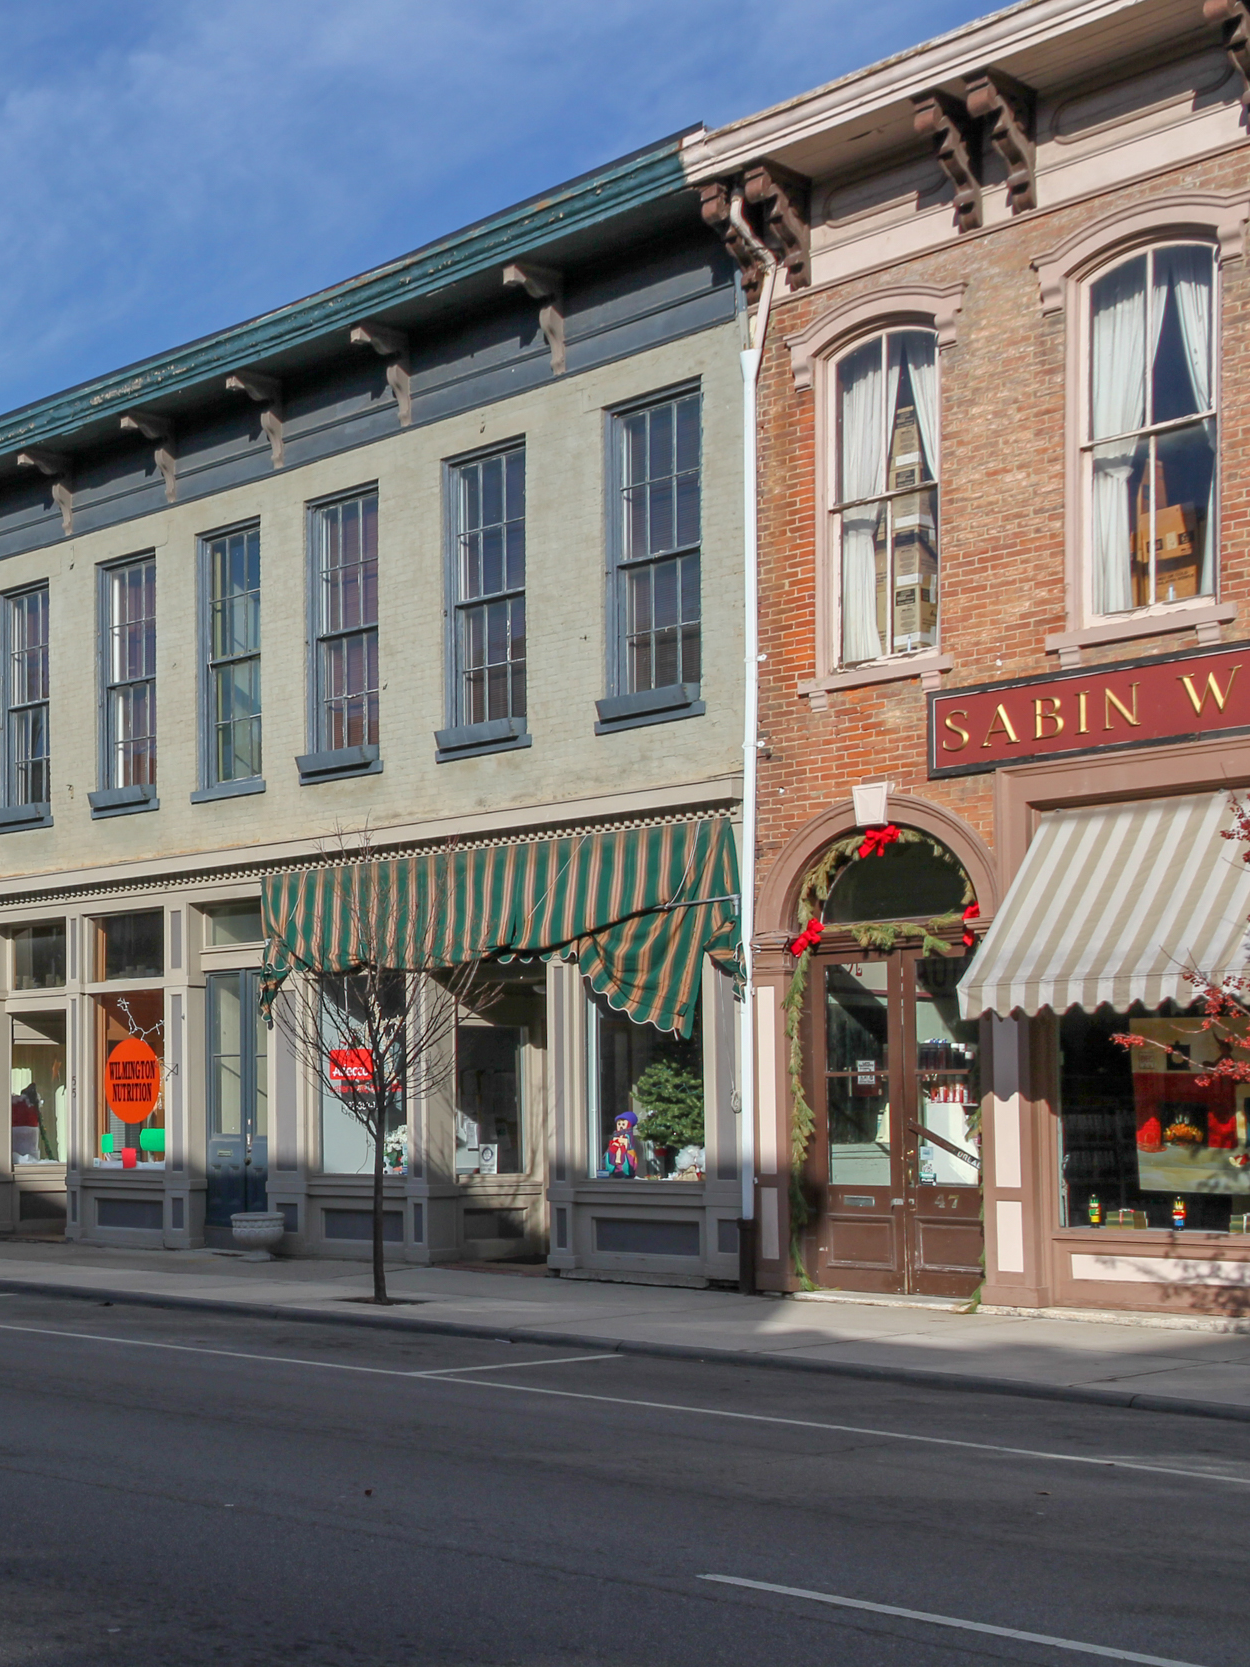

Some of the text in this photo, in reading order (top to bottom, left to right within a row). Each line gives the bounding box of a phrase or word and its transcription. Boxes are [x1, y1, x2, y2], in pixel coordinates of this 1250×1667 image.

[942, 682, 1142, 752] SABIN
[109, 1060, 155, 1080] WILMINGTON
[112, 1082, 152, 1102] NUTRITION
[934, 1193, 960, 1209] 47
